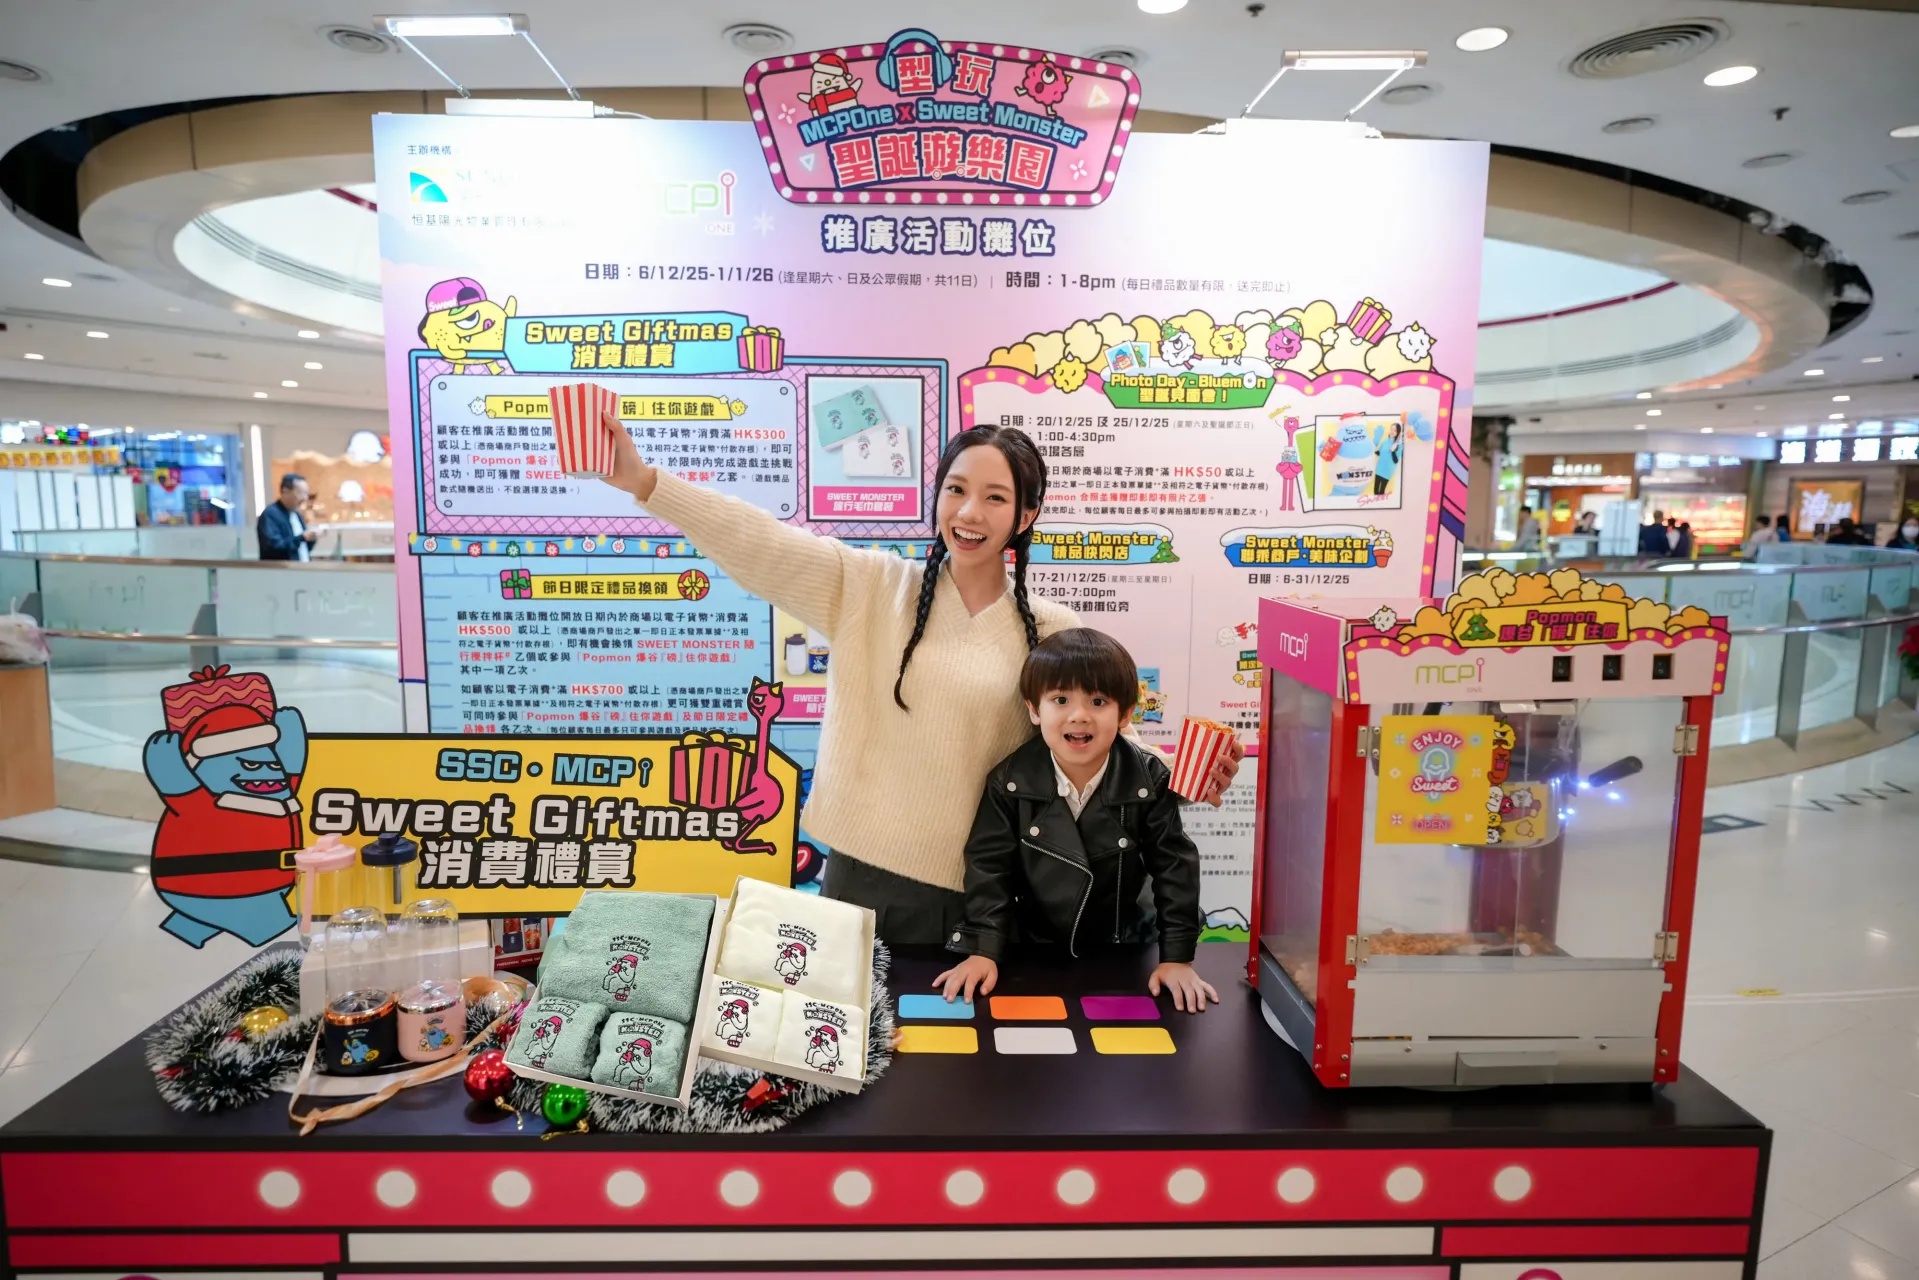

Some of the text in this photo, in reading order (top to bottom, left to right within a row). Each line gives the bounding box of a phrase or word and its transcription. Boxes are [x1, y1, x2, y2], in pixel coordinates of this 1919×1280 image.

[800, 107, 893, 144] MCPOne
[918, 100, 988, 123] Sweet
[994, 105, 1086, 145] Monster
[830, 132, 1055, 190] 聖誕遊樂園
[824, 217, 1054, 255] 推廣活動攤位
[639, 265, 774, 283] 6/12/25-1/1/26
[526, 319, 732, 344] Sweet Giftmas
[571, 343, 675, 370] 消費禮賞
[1110, 373, 1153, 387] Photo
[1156, 374, 1186, 389] Day
[1036, 416, 1093, 427] 20/12/25
[1113, 417, 1169, 428] 25/12/25
[734, 429, 786, 440] HK$300
[1037, 432, 1115, 443] 1:00-4:30pm
[1174, 467, 1222, 477] HK$50
[827, 493, 905, 501] SWEET MONSTER
[1032, 531, 1157, 545] Sweet Monster
[1245, 535, 1370, 549] Sweet Monster
[1052, 545, 1130, 560] 精品快閃店
[1032, 573, 1107, 583] 17-21/12/25
[1283, 574, 1350, 584] 6-31/12/25
[1527, 610, 1597, 626] Popmon
[458, 625, 511, 636] HK$500
[637, 640, 678, 649] SWEET
[682, 640, 740, 649] MONSTER
[571, 685, 623, 696] HK$700
[1413, 731, 1463, 750] ENJOY
[437, 749, 520, 782] SSC
[1412, 777, 1459, 793] Sweet
[313, 791, 740, 840] Sweet Giftmas
[1415, 819, 1449, 832] OPEN
[420, 839, 636, 888] 消費禮賞
